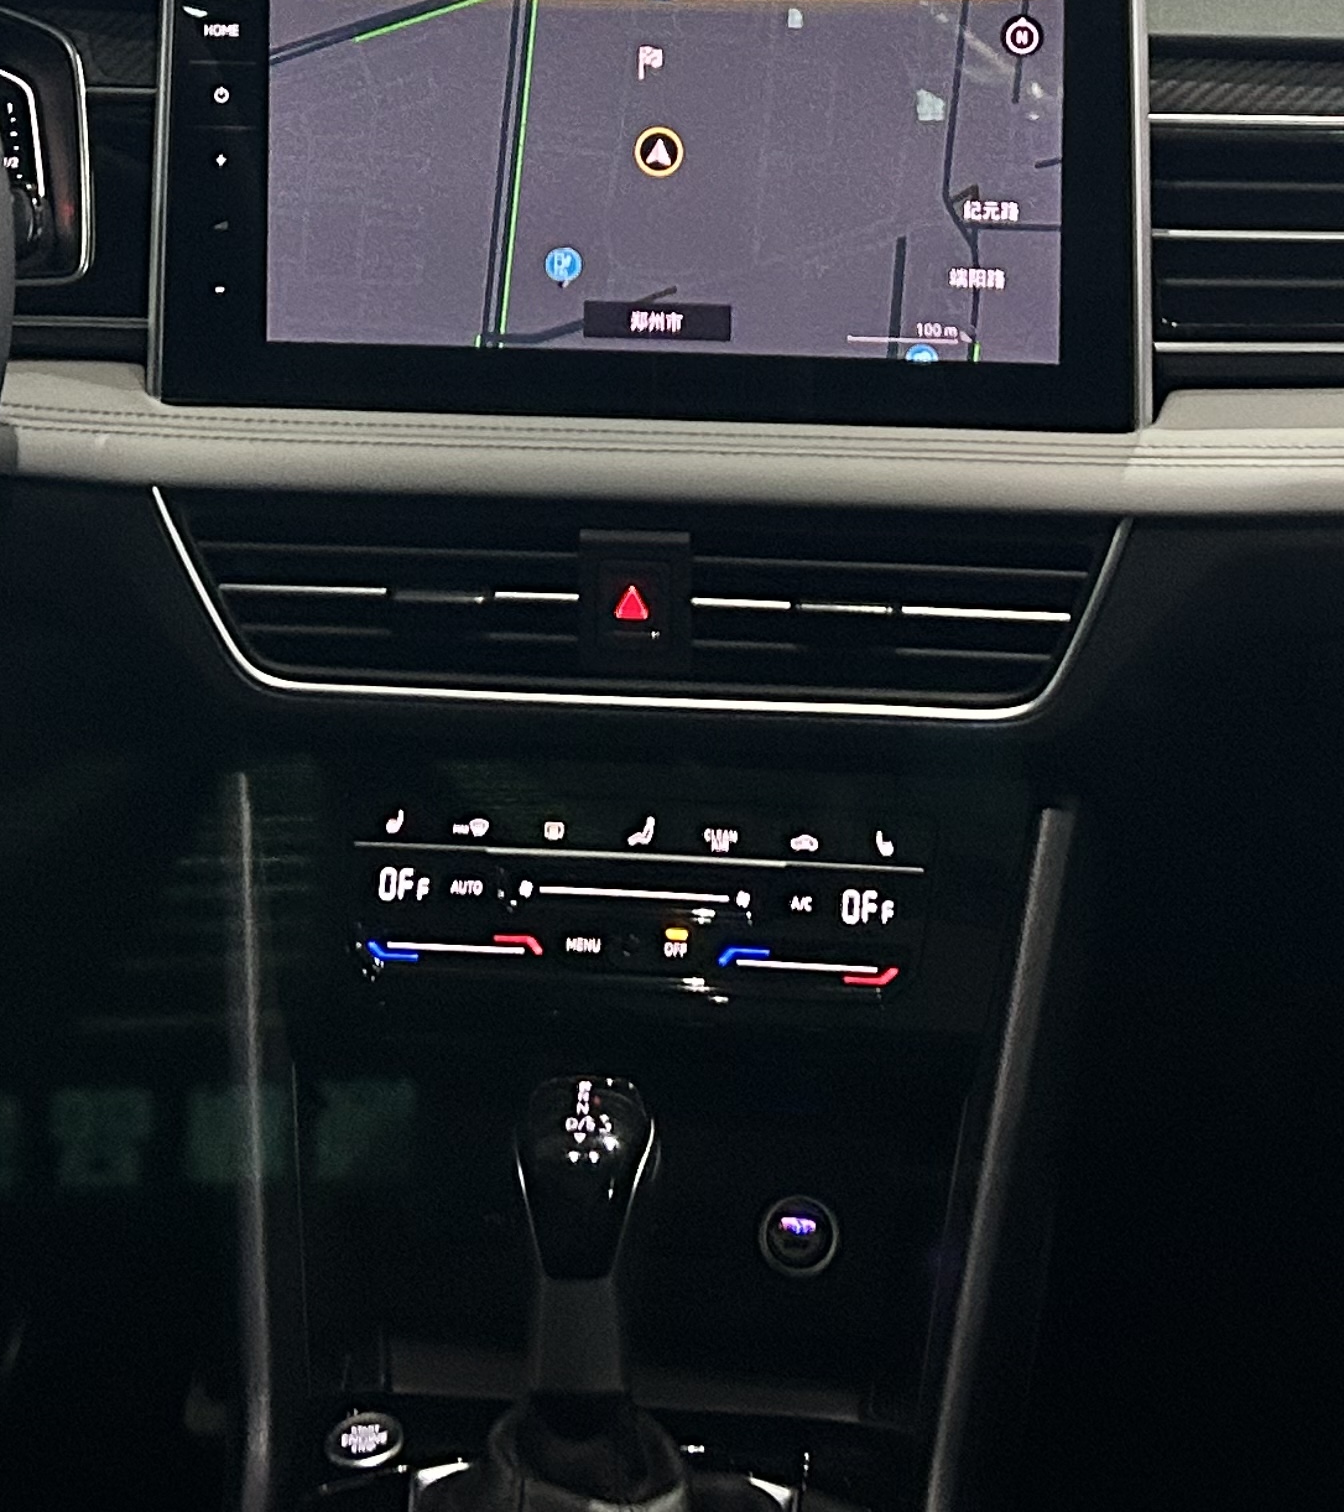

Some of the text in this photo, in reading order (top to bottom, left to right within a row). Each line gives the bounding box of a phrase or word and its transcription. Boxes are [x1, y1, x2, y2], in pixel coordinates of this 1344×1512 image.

[203, 24, 240, 37] HOME
[450, 880, 483, 896] AUTO
[565, 937, 601, 954] MENU
[664, 942, 687, 958] OFF
